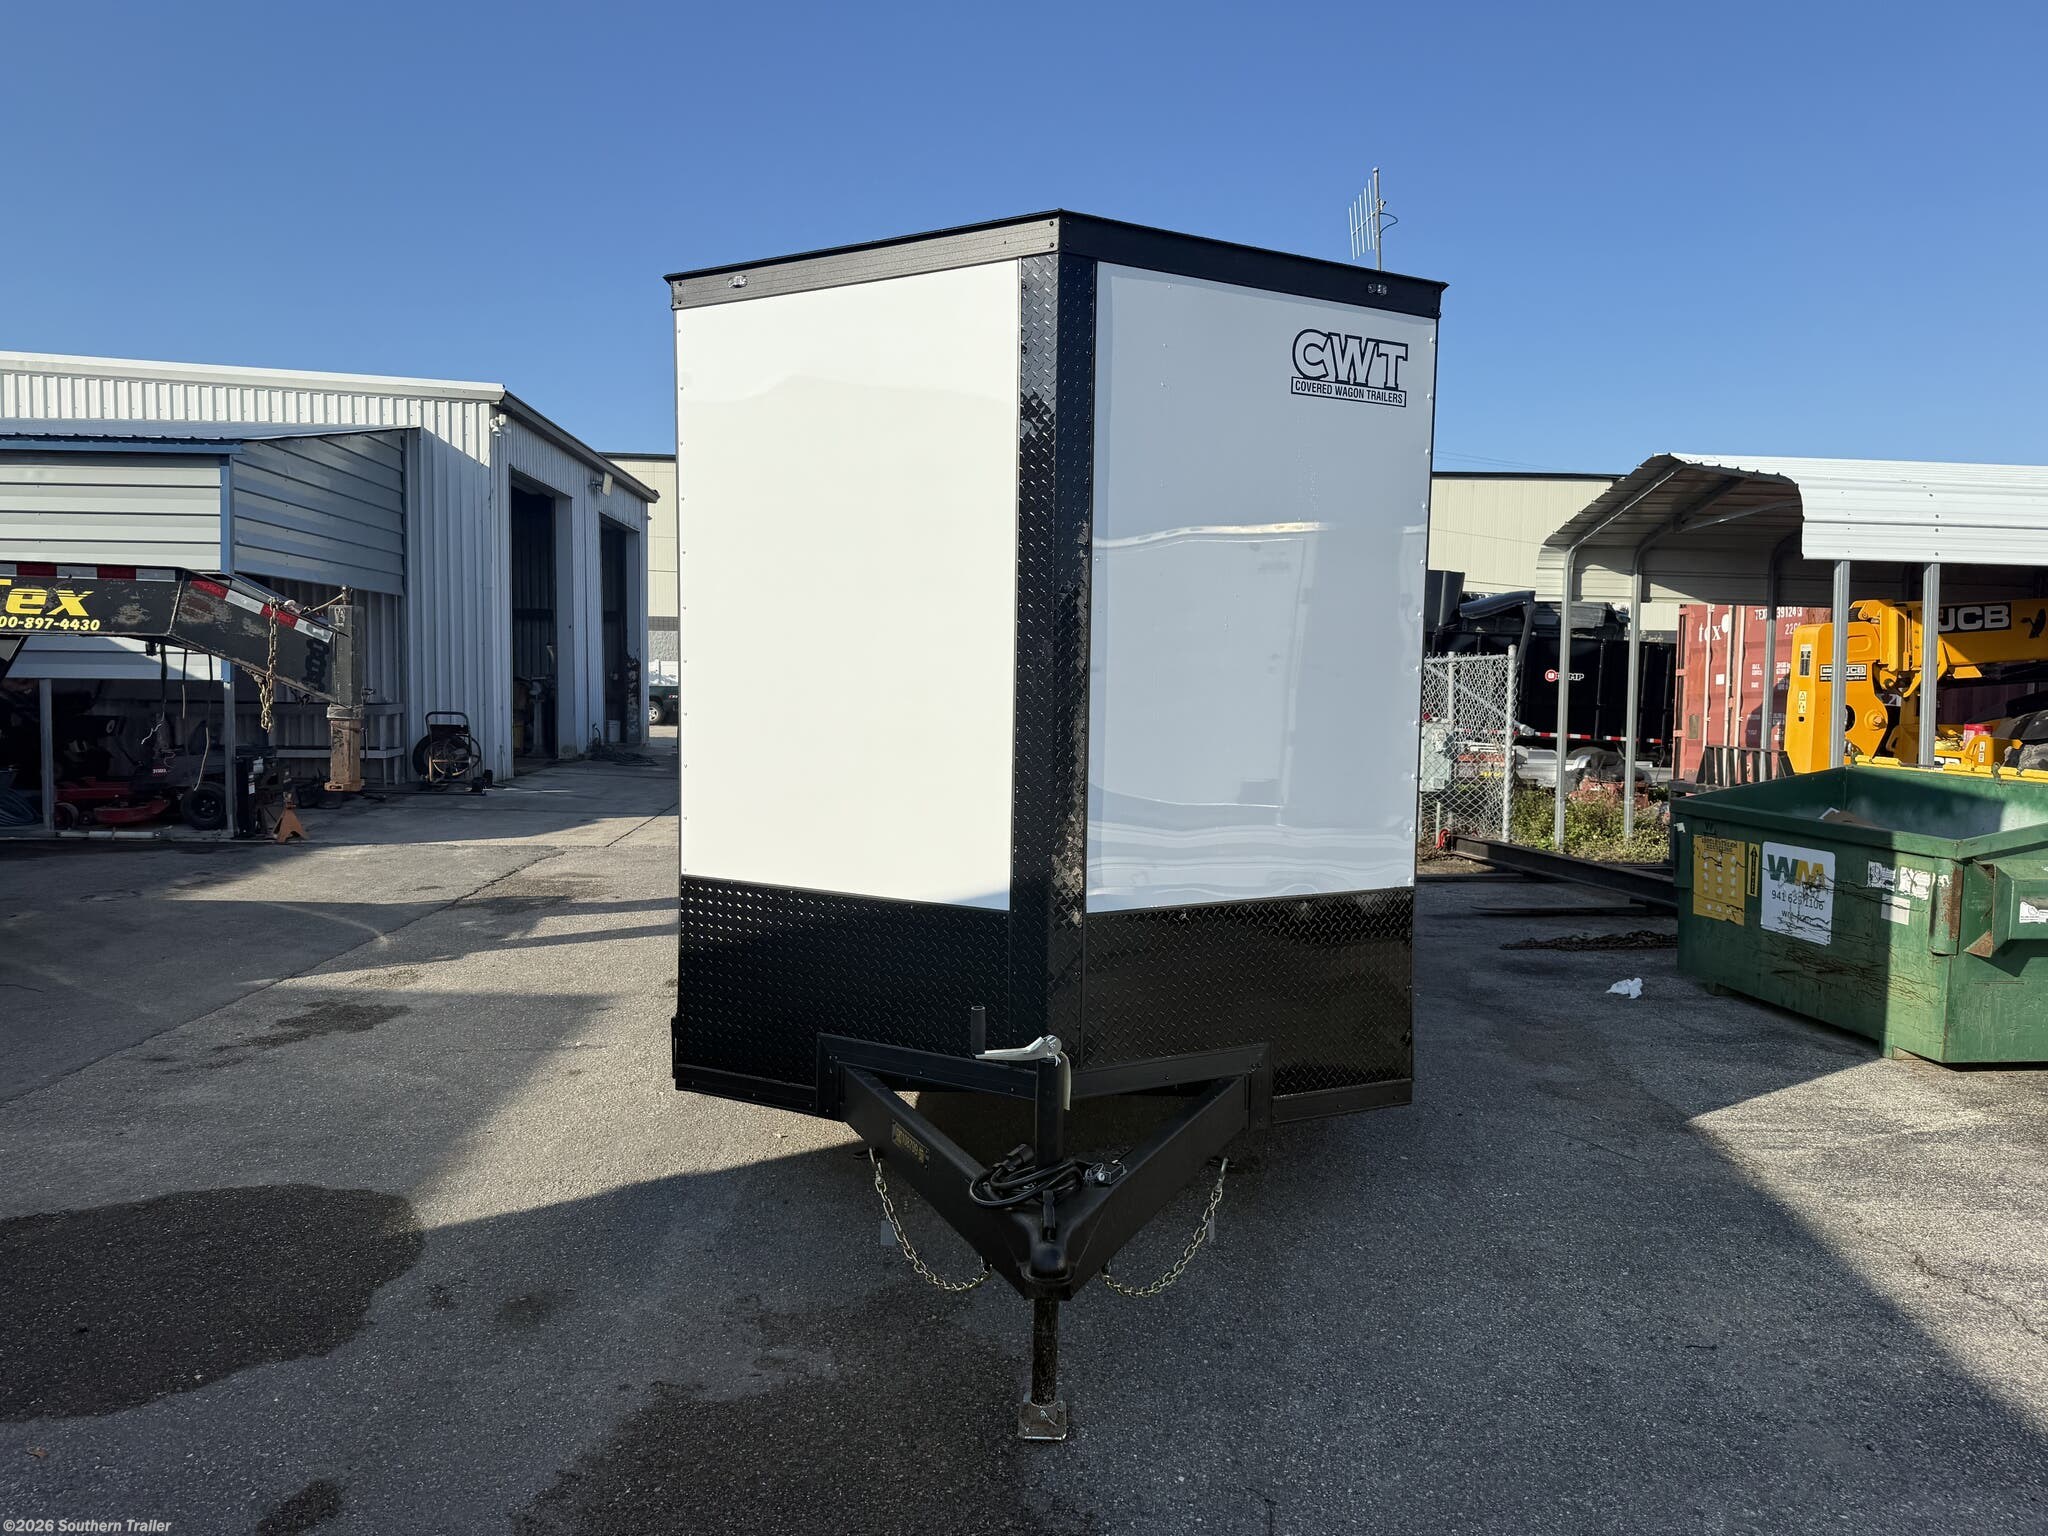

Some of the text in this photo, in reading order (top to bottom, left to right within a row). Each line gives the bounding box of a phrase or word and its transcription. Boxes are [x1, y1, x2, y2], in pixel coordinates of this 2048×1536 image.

[1292, 328, 1408, 390] CWT
[1295, 380, 1403, 404] COVERED WAGON TRAILERS
[0, 579, 94, 616] ex
[1938, 605, 2010, 632] JCB
[1767, 854, 1826, 887] WM
[1771, 889, 1786, 902] 941
